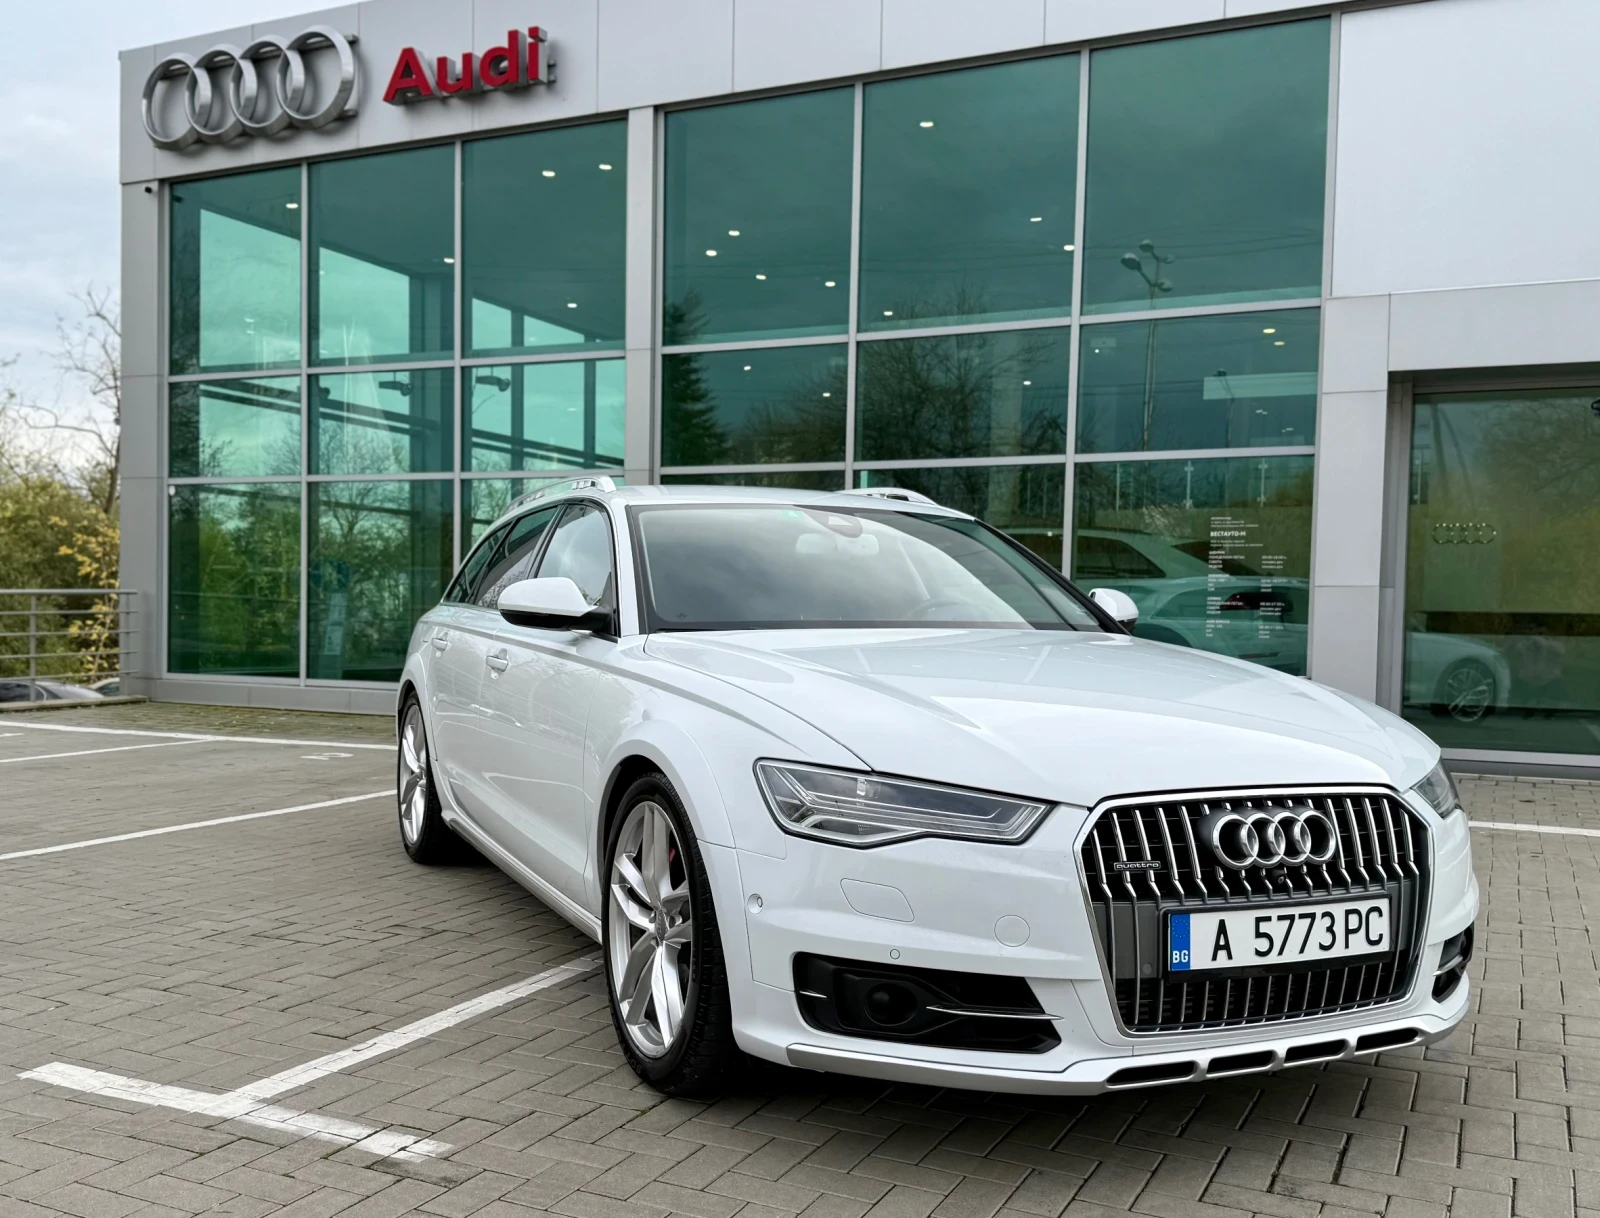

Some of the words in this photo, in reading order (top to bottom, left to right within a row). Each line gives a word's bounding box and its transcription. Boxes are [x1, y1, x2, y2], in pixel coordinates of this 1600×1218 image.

[383, 26, 543, 102] Audi
[1172, 950, 1189, 964] BG
[1211, 918, 1233, 962] A
